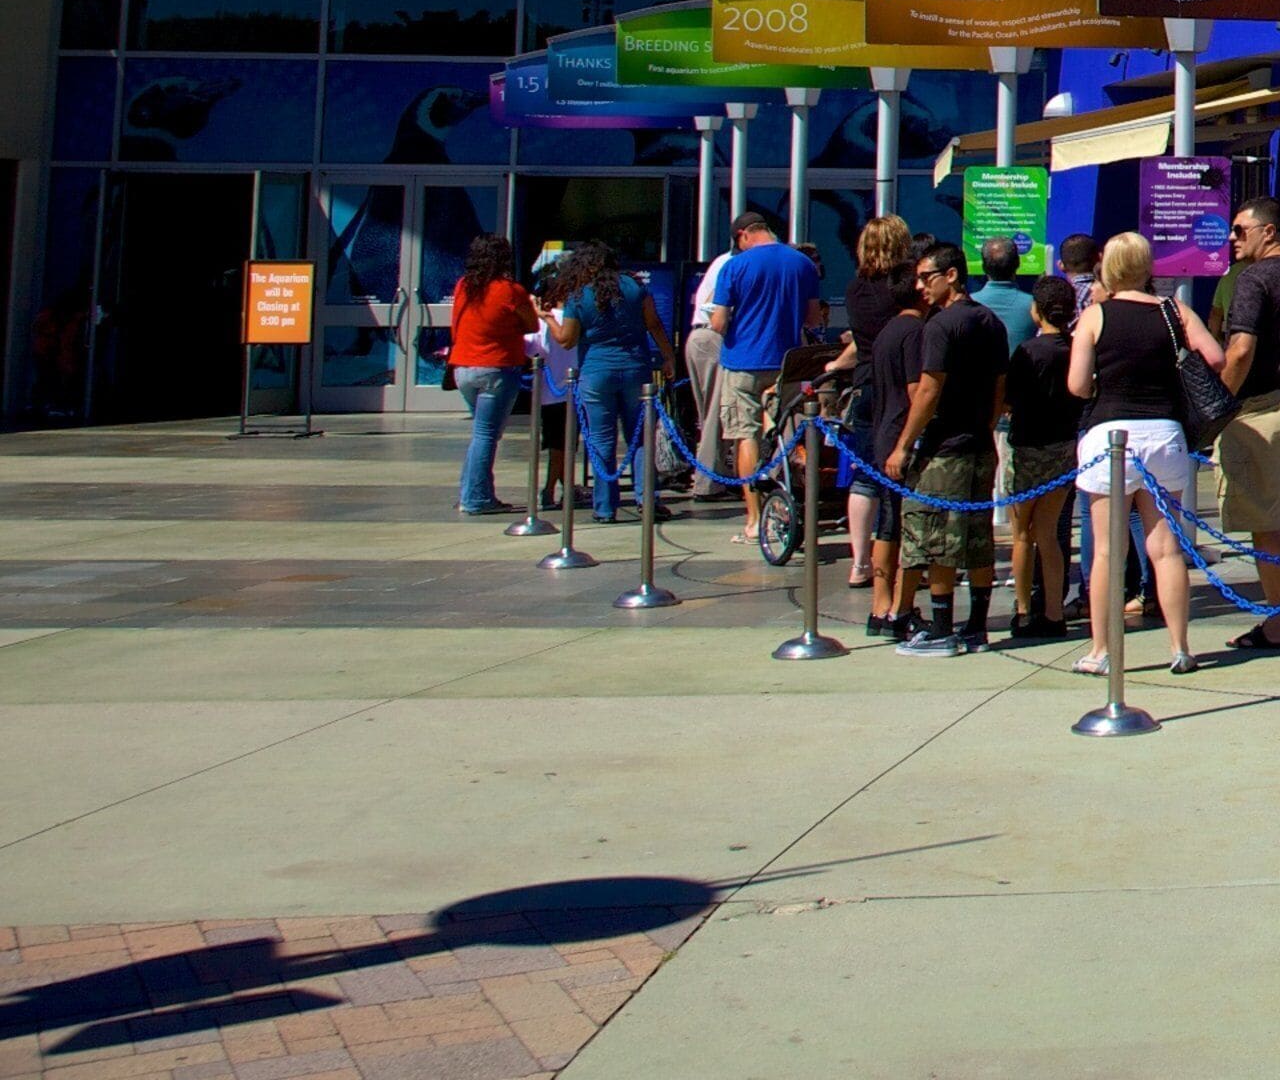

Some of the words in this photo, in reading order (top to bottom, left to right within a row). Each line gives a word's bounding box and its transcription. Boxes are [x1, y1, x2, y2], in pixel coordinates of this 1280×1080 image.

[722, 2, 809, 33] 2008
[1027, 14, 1040, 23] and
[959, 29, 971, 38] the
[1068, 18, 1081, 27] and
[624, 35, 700, 53] BREEDING
[556, 52, 613, 69] THANKS
[517, 76, 540, 93] 1.5
[1158, 163, 1210, 172] Membership
[981, 173, 1029, 181] Membership
[1167, 234, 1187, 242] today!
[251, 273, 266, 283] The
[268, 273, 309, 285] Aquarium
[264, 287, 281, 297] will
[283, 287, 294, 297] be
[257, 302, 290, 314] Closing
[291, 302, 300, 311] at
[281, 317, 296, 328] pm
